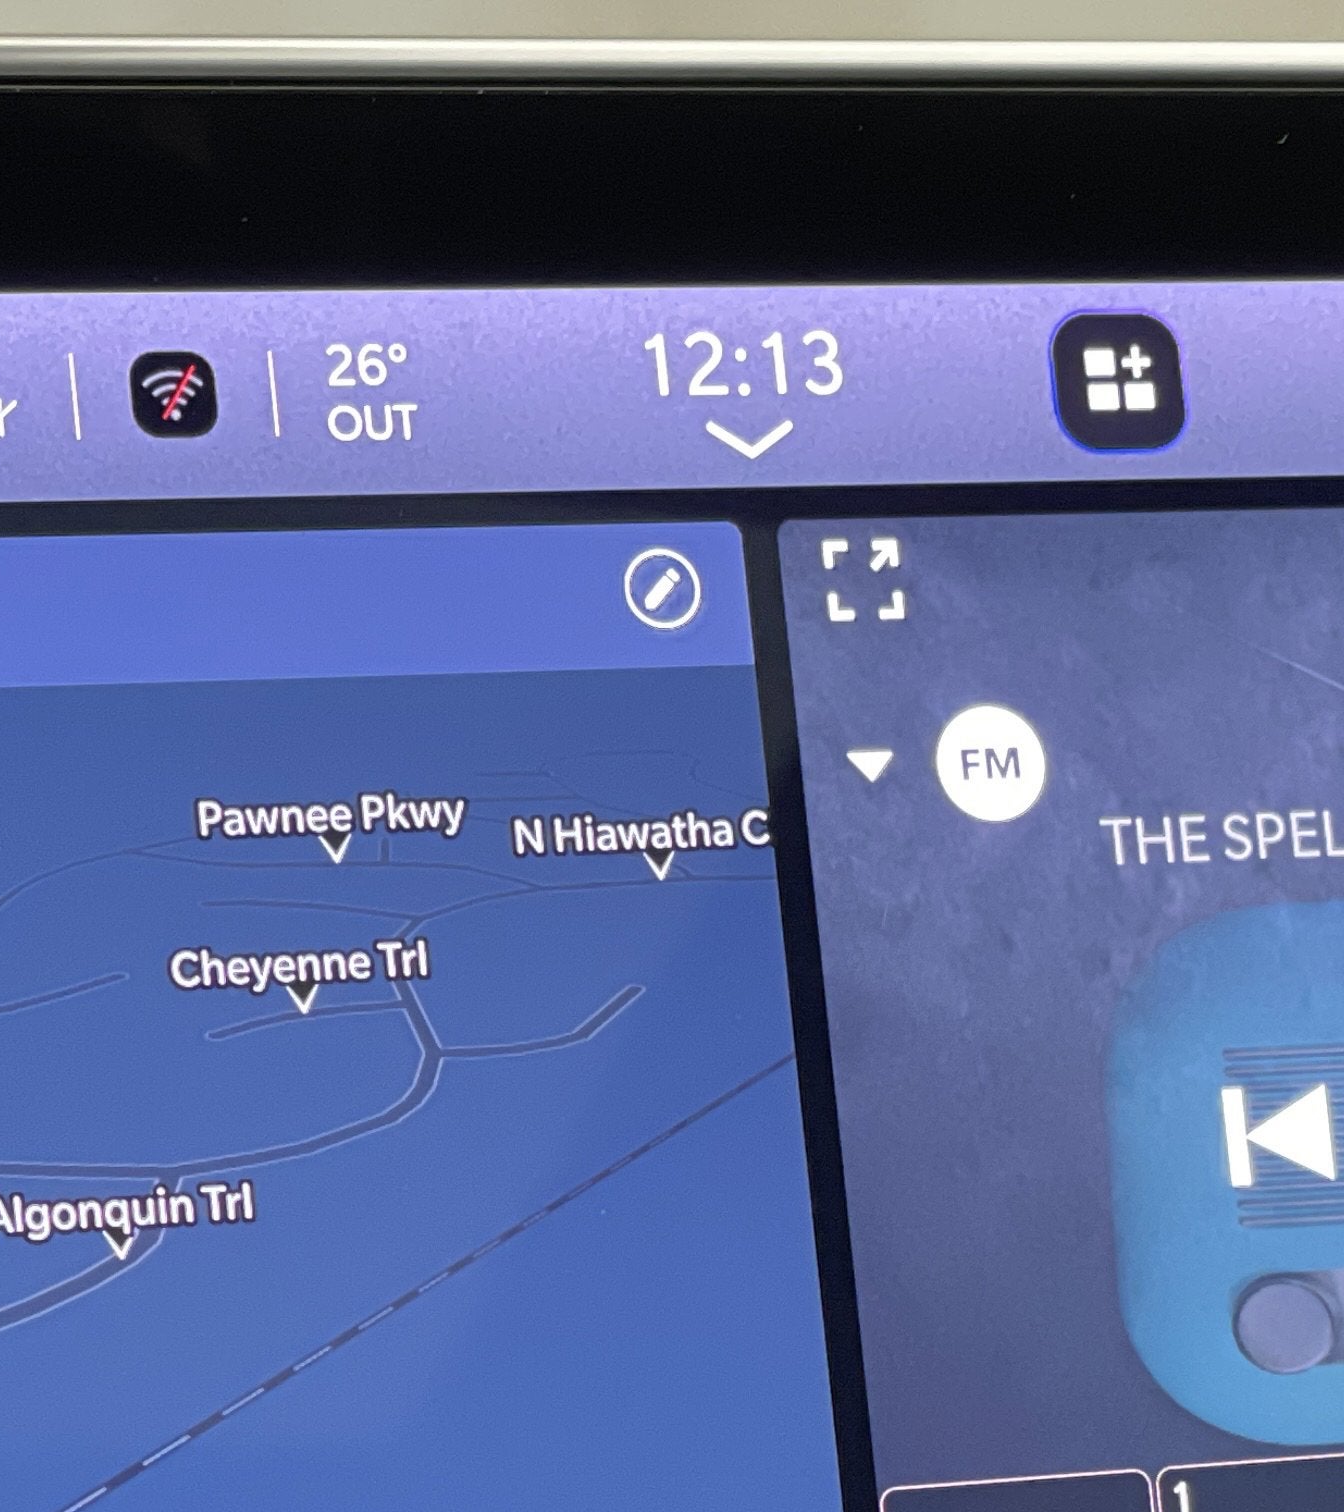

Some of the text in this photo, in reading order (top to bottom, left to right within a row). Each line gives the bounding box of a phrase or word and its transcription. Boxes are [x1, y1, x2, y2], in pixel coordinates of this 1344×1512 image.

[643, 330, 846, 399] 12:13
[326, 402, 419, 445] OUT
[959, 747, 1022, 782] FM
[196, 794, 465, 838] Pawnee Pkwy
[512, 819, 544, 855] N
[552, 812, 734, 852] Hiawatha
[1098, 815, 1208, 866] THE
[169, 940, 428, 992] Cheyenne Trl
[198, 1182, 254, 1222] Trl
